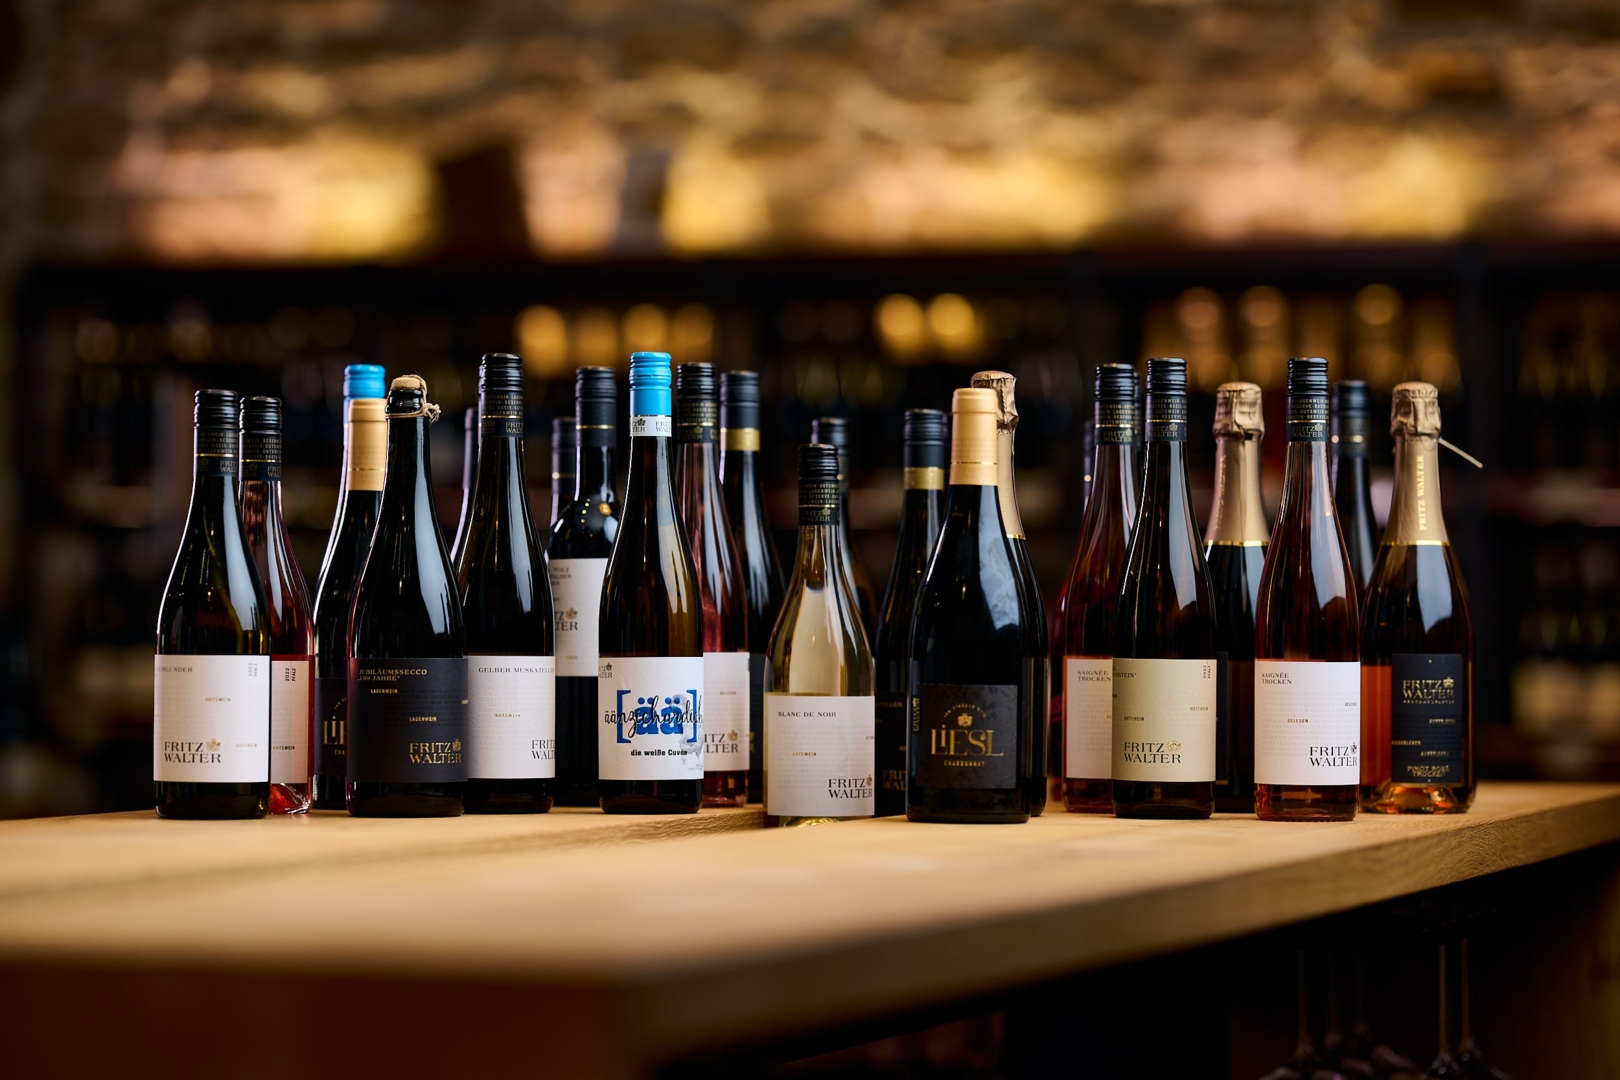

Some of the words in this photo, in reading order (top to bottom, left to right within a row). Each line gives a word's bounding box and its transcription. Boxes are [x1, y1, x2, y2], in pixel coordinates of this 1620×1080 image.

[1416, 454, 1424, 497] WALTER
[1418, 499, 1427, 531] FRITZ
[1402, 680, 1442, 689] FRITZ
[1402, 689, 1454, 699] WALTER
[164, 741, 204, 752] FRITZ
[409, 742, 451, 753] FRITZ
[1124, 742, 1165, 753] FRITZ
[1309, 746, 1349, 756] FRITZ
[164, 753, 221, 764] WALTER
[409, 754, 461, 764] WALTER
[1124, 753, 1181, 764] WALTER
[1309, 757, 1358, 767] WALTER
[828, 779, 866, 788] FRITZ
[828, 789, 872, 798] WALTER
